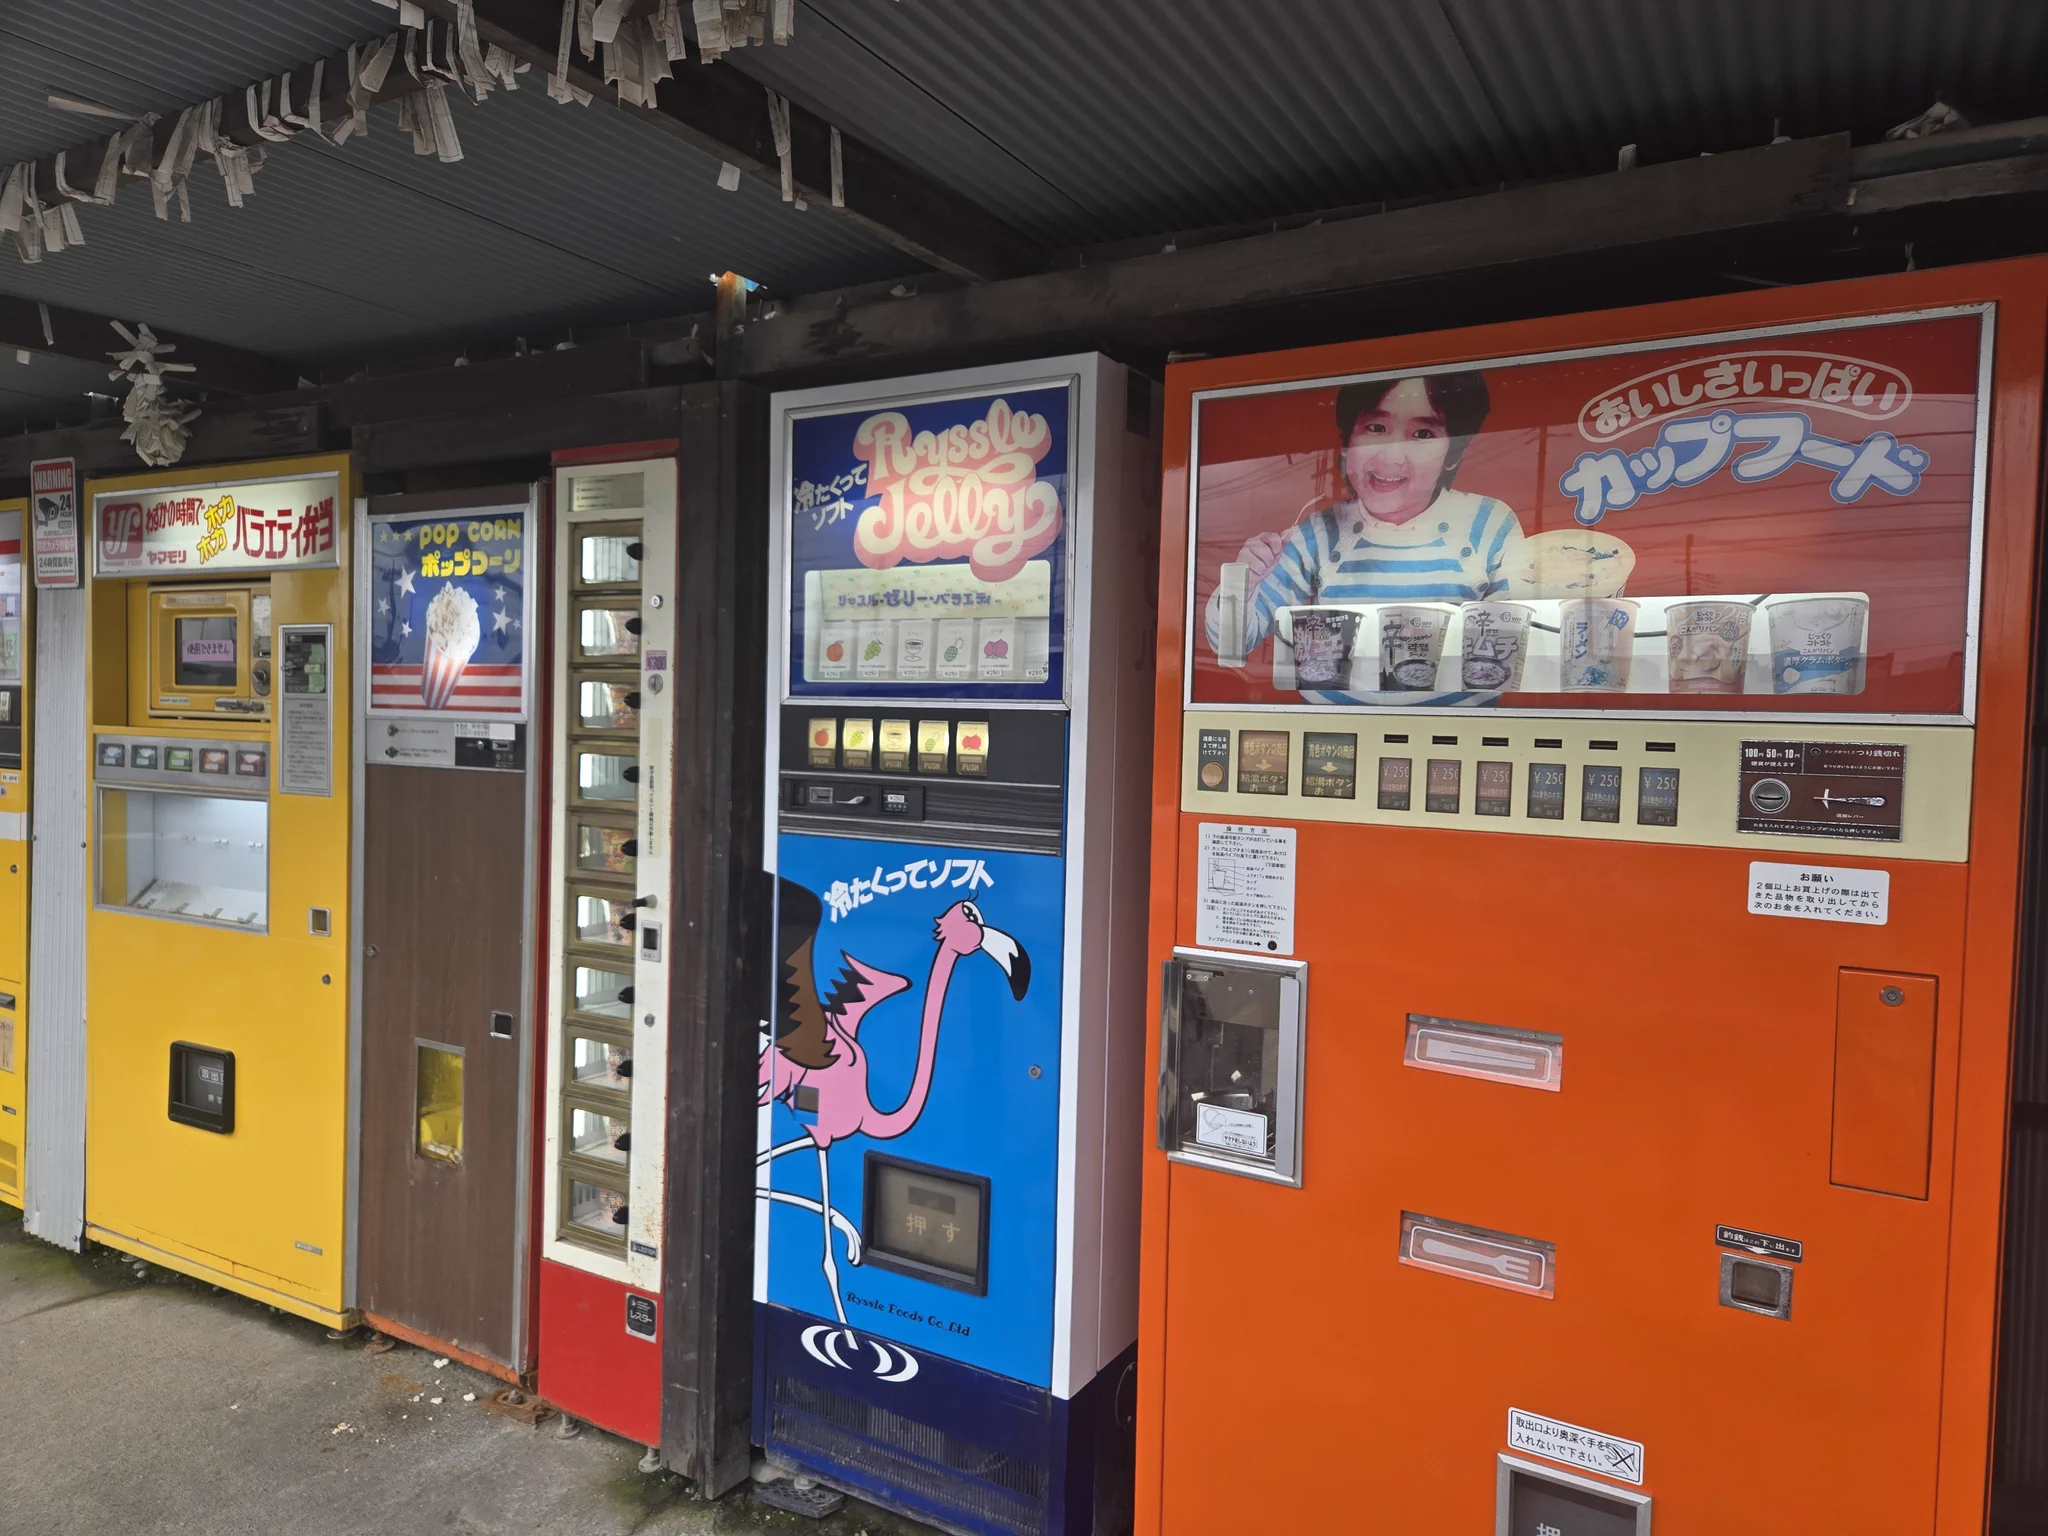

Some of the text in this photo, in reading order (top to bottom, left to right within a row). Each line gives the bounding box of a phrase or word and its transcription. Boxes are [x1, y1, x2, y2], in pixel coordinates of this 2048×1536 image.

[1590, 360, 1897, 434] おいしさいっぱい
[856, 398, 1049, 494] Ryssle
[1563, 412, 1926, 523] カップフード
[34, 468, 72, 490] WARNING
[794, 463, 868, 515] 冷たくって
[60, 494, 71, 511] 24
[146, 497, 206, 534] わずかの時間で
[204, 495, 235, 533] ホカ
[812, 499, 855, 531] ソフト
[857, 472, 1058, 567] Jelly
[233, 497, 333, 560] バラエティ弁当
[468, 518, 521, 543] CORN
[196, 528, 228, 565] ホカ
[147, 550, 187, 565] ヤマモリ
[421, 548, 521, 578] ポップコーン
[1476, 610, 1495, 637] 辛
[1680, 625, 1720, 634] こんがりパン
[1382, 620, 1410, 666] 辛
[1575, 622, 1588, 659] ラーメン
[1808, 632, 1832, 640] じっくり
[1308, 744, 1355, 759] 青色ボタンの商品
[1745, 748, 1800, 759] 100円 50円 10円
[848, 758, 864, 766] PUSH
[885, 760, 902, 768] PUSH
[923, 762, 940, 770] PUSH
[962, 763, 979, 771] PUSH
[1241, 774, 1286, 784] 給湯ボタン
[1383, 766, 1389, 778] ¥
[1431, 768, 1438, 779] ¥
[1481, 770, 1488, 782] ¥
[1534, 771, 1541, 784] ¥
[1588, 773, 1619, 787] ¥ 250
[1306, 776, 1353, 787] 給湯ボタン
[1644, 776, 1677, 790] ¥ 250
[1800, 872, 1834, 883] お願い
[824, 859, 995, 923] 冷たくってソフト
[1756, 881, 1879, 899] 2個以上お買上げの際は出て
[1754, 891, 1879, 909] きた品物を取り出してから
[1754, 901, 1879, 919] 次のお金を入れてください。
[846, 1291, 885, 1312] Ryssle
[888, 1303, 924, 1323] Foods
[1516, 1416, 1606, 1451] 取出口より奥深く手を
[1516, 1432, 1602, 1466] 入れないで下さい。
